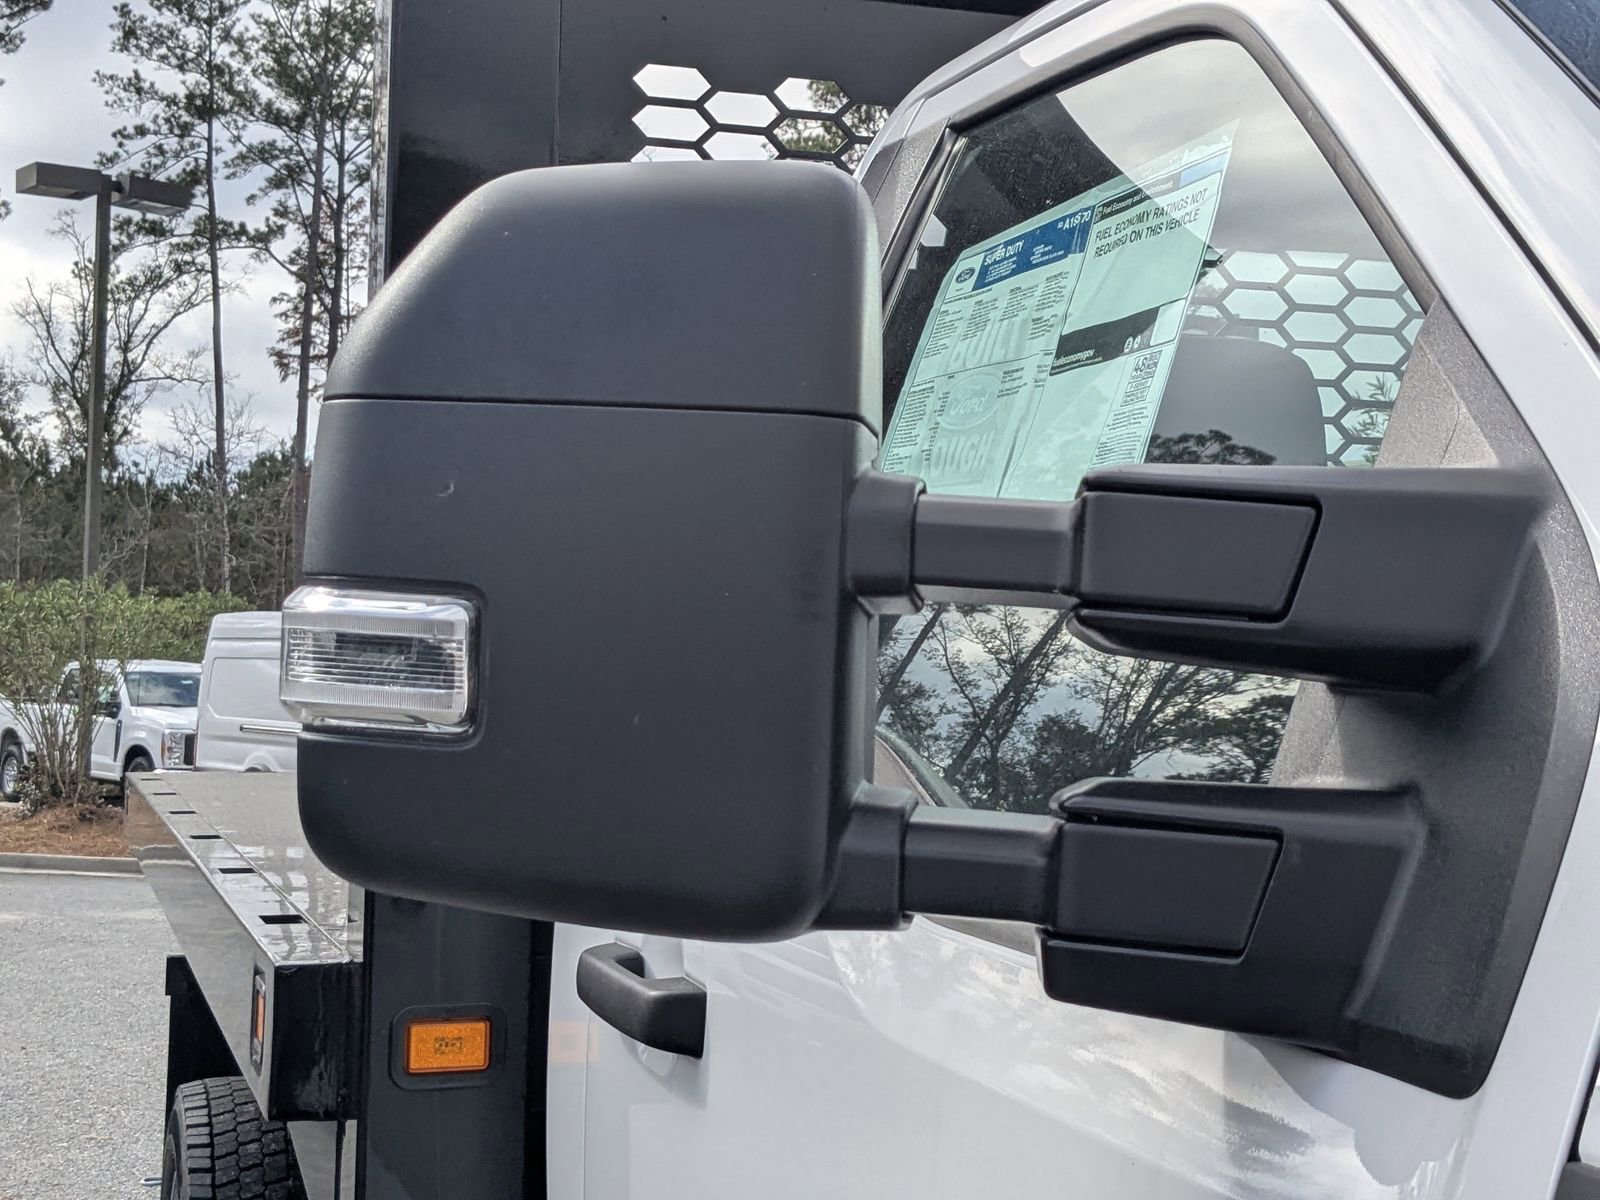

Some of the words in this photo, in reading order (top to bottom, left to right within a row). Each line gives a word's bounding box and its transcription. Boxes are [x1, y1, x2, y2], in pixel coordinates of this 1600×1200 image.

[1095, 225, 1113, 244] FUEL
[1114, 210, 1152, 235] ECONOMY
[1152, 193, 1190, 221] RATINGS
[1190, 187, 1208, 205] NOT
[1112, 197, 1134, 212] Economy
[1094, 237, 1129, 259] REQUIRED
[1129, 228, 1144, 244] ON
[1145, 221, 1165, 241] THIS
[1165, 208, 1200, 232] VEHICLE
[984, 247, 1006, 266] SUPER
[1006, 240, 1025, 258] DUTY
[1133, 356, 1148, 374] 48
